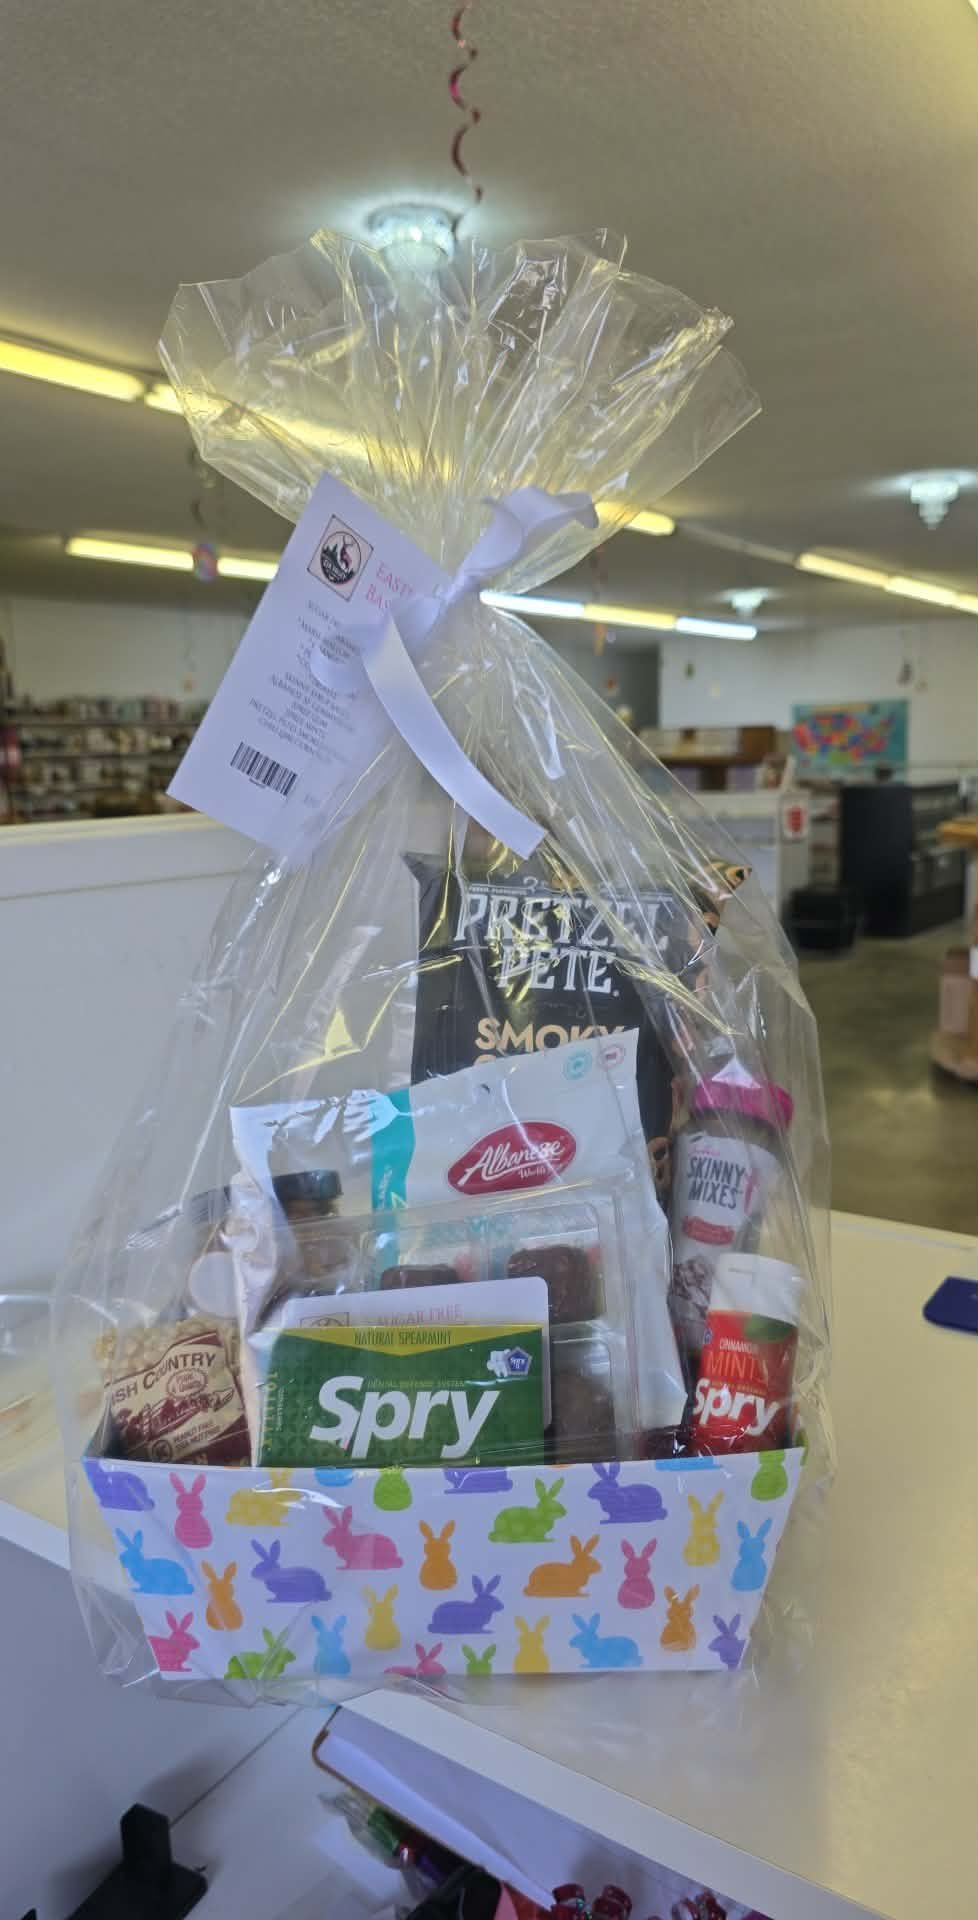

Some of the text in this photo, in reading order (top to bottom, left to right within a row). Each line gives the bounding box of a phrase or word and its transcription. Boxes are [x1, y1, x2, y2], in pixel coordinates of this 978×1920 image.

[453, 893, 669, 950] PRETZEL
[475, 1016, 625, 1056] SMOK
[457, 1140, 566, 1186] Albanese
[687, 1156, 746, 1193] SKINNY
[688, 1181, 737, 1210] MIXES
[354, 1329, 452, 1345] NATURAL SPEARMINT
[143, 1352, 216, 1390] COUNTRY
[310, 1375, 501, 1460] Spry
[693, 1378, 780, 1436] Spry
